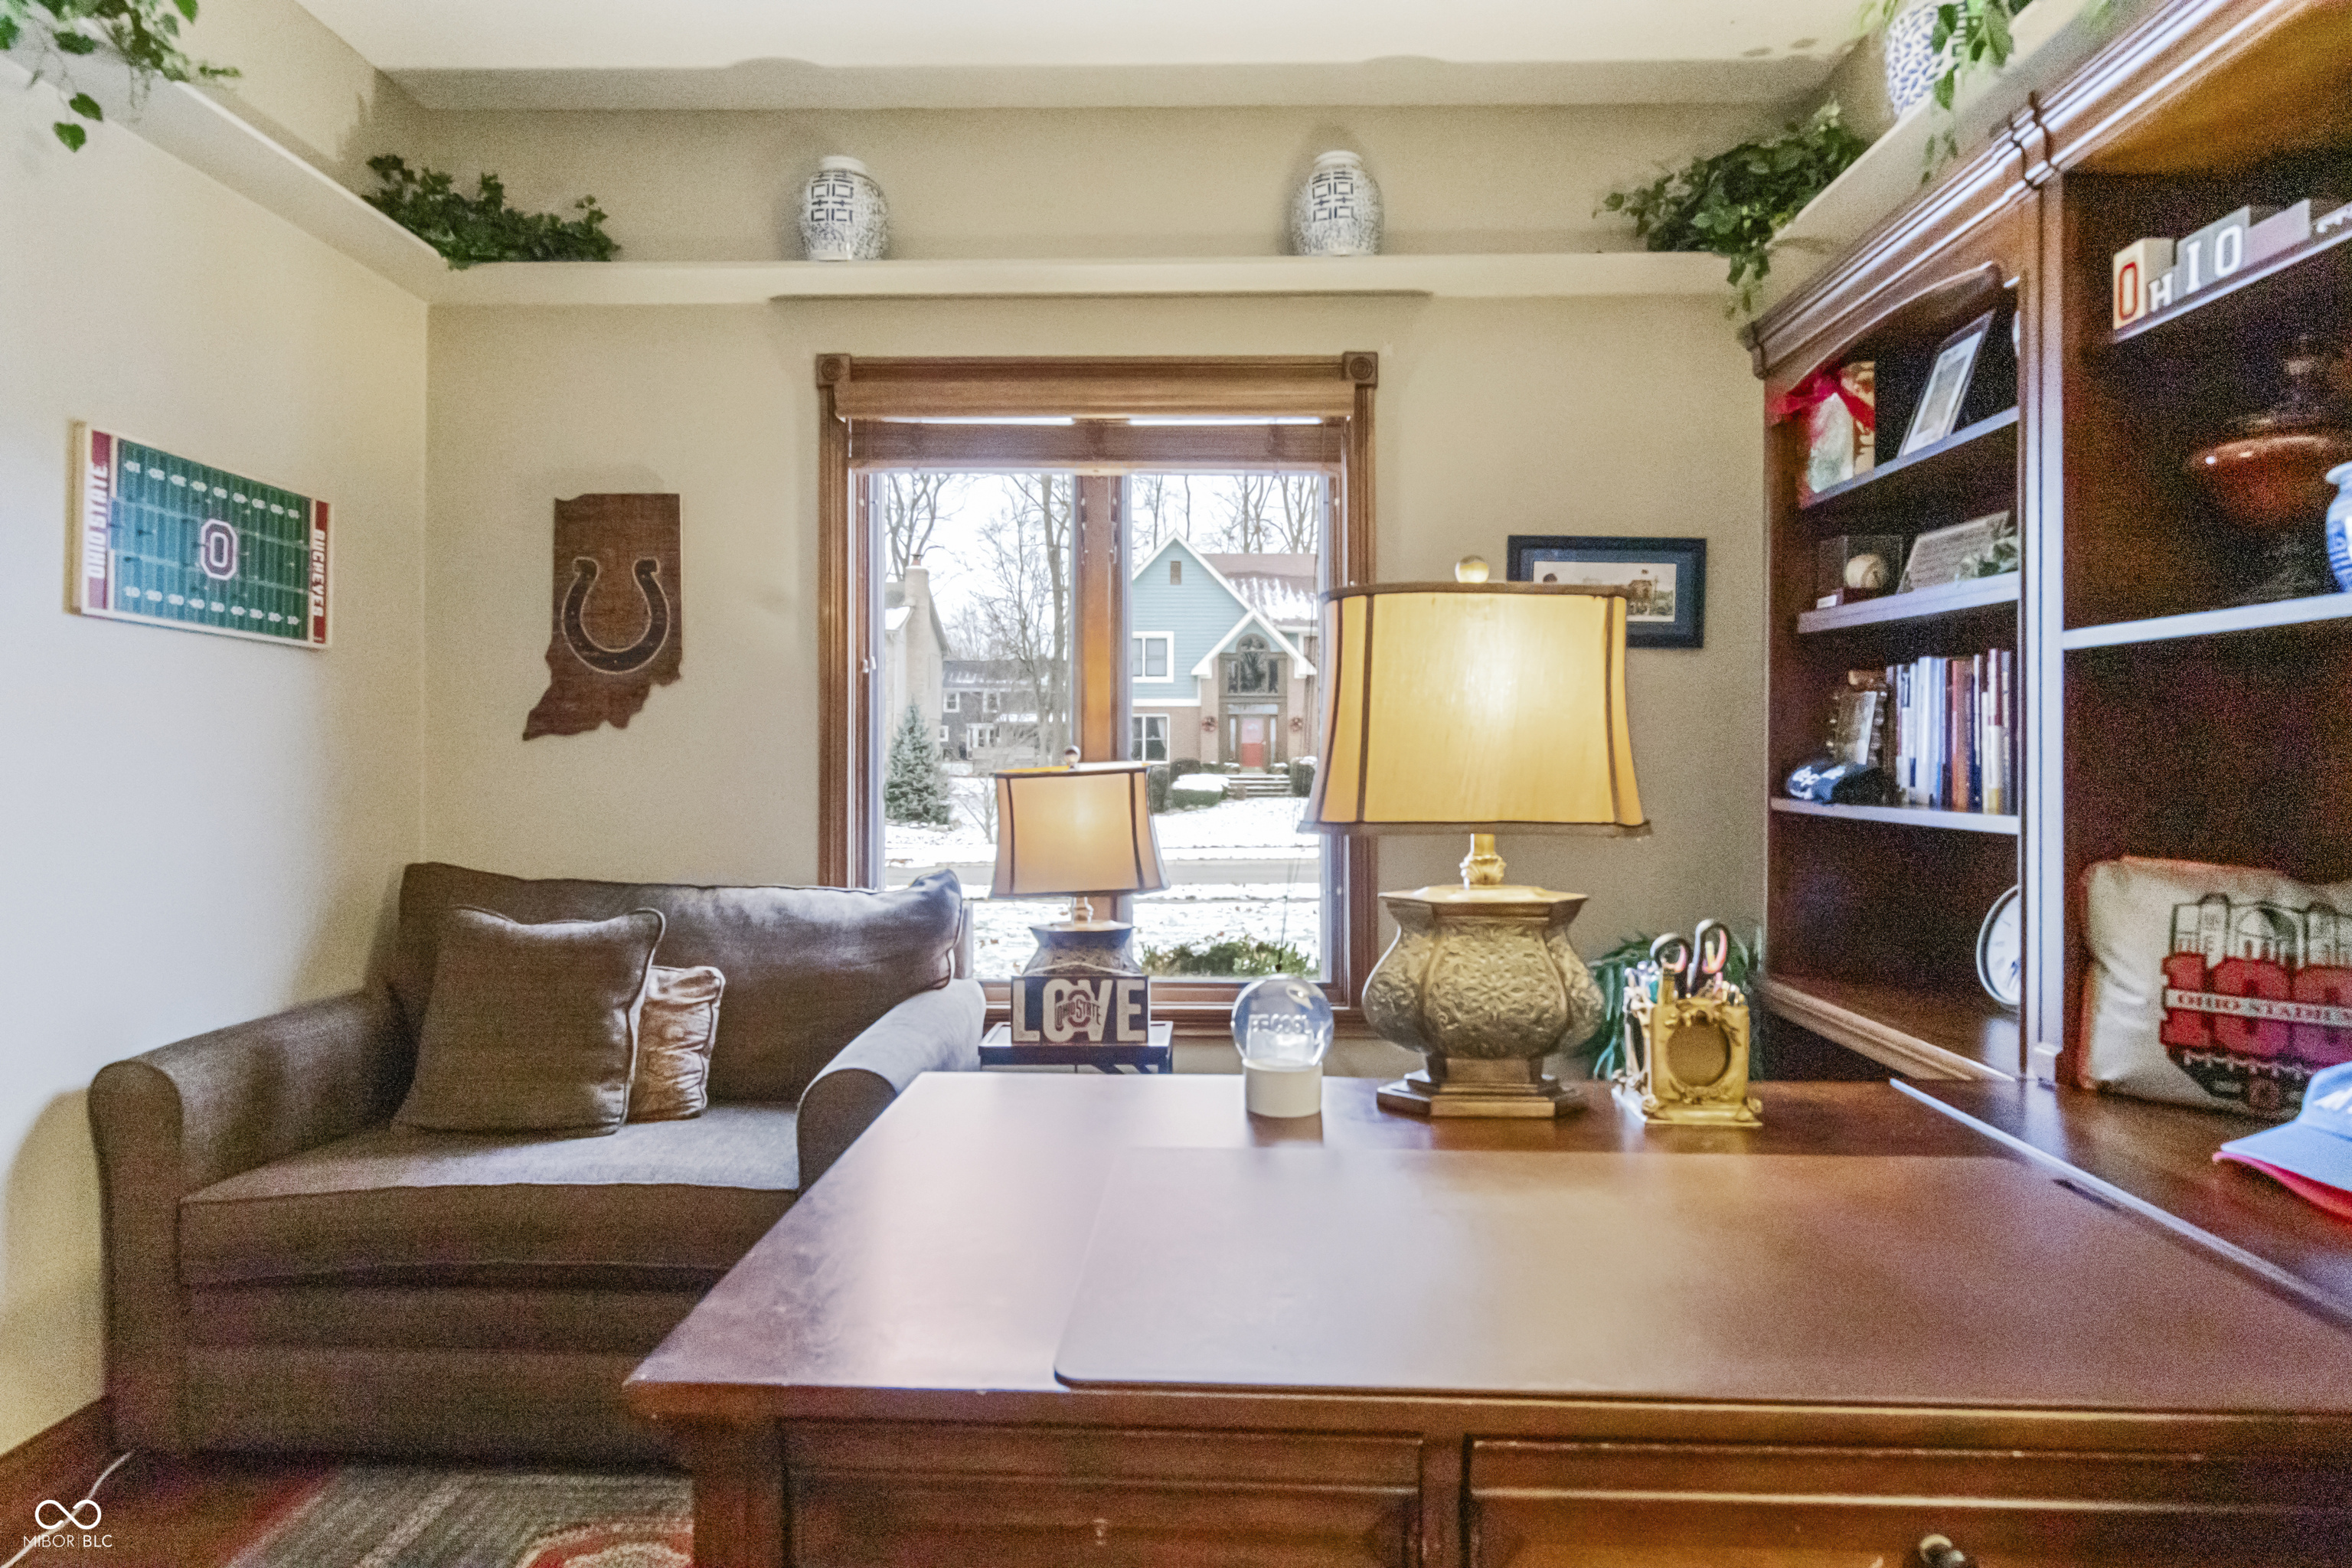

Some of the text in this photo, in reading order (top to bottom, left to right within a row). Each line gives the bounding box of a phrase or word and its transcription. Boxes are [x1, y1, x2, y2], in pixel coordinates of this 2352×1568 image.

[2118, 224, 2243, 321] OHIO
[88, 463, 109, 580] OHIO STATE
[1012, 978, 1146, 1042] LOVE
[1076, 998, 1101, 1026] STATE
